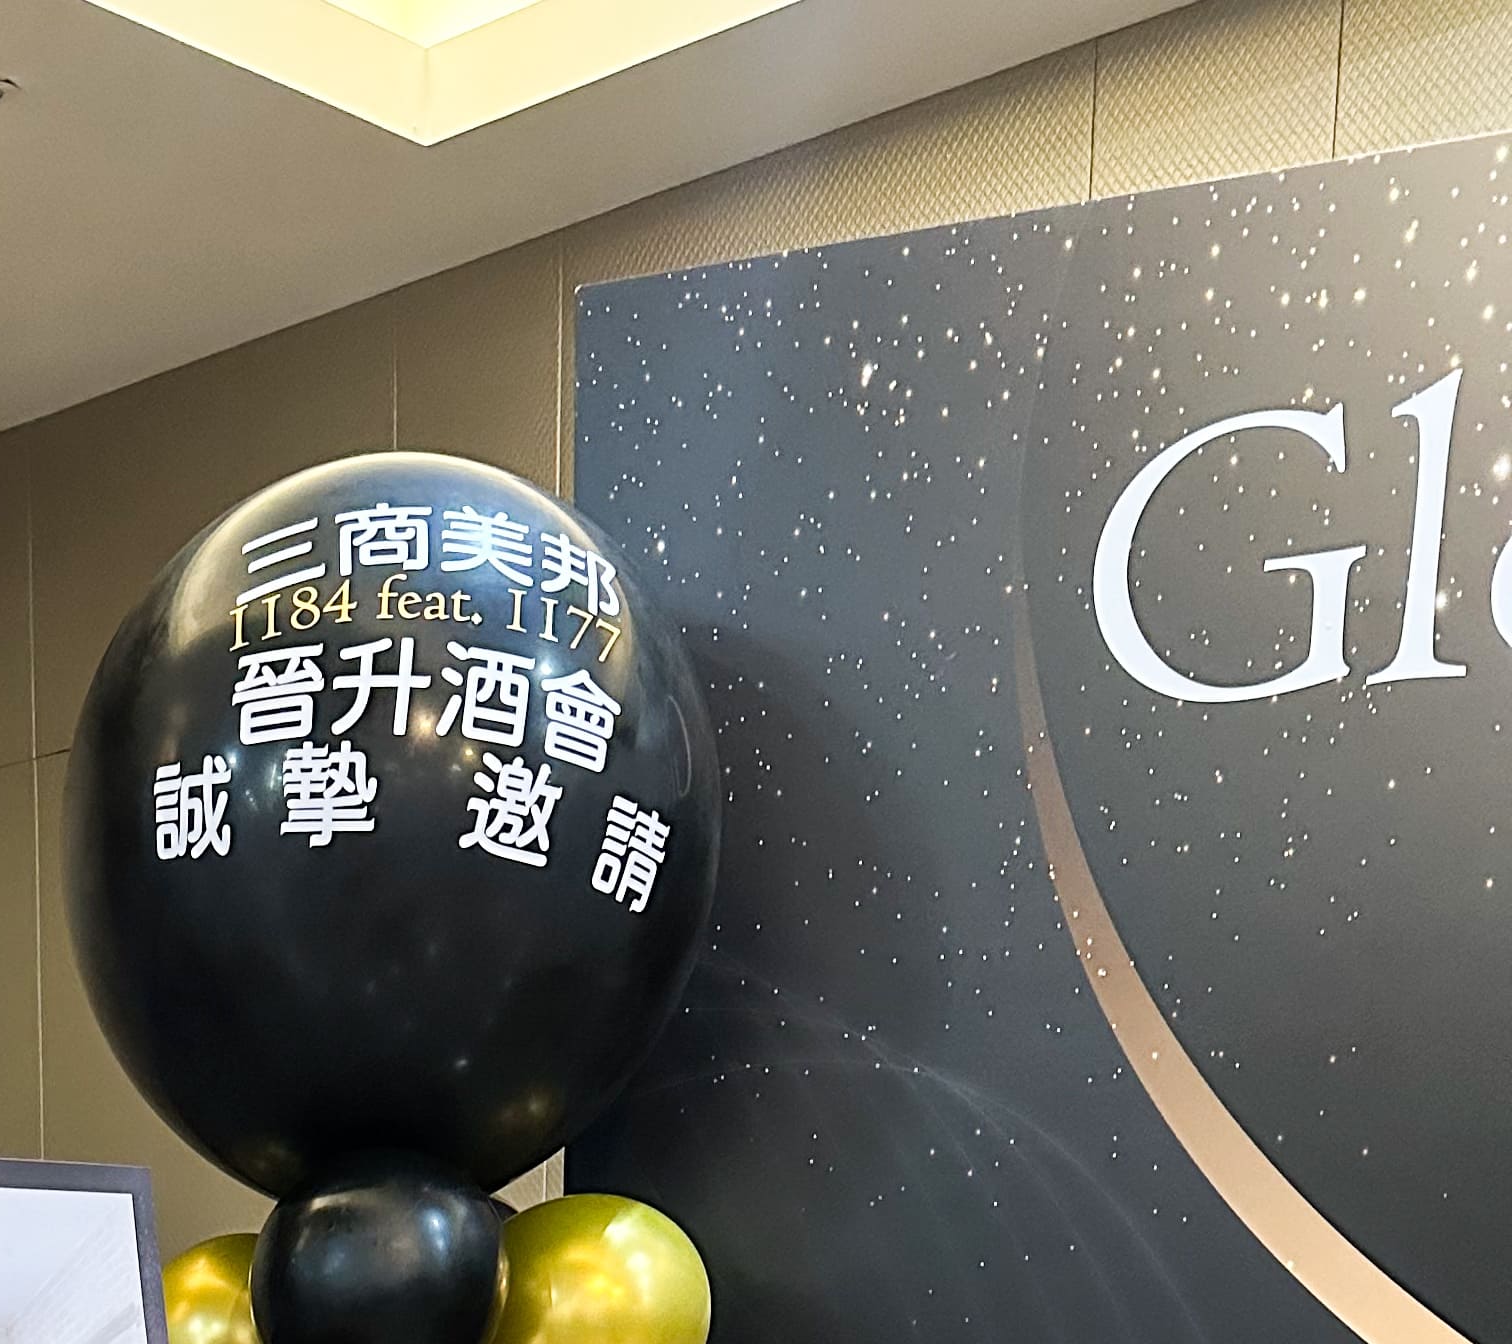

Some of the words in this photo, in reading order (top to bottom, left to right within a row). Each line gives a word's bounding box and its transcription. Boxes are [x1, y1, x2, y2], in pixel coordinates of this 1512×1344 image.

[236, 502, 621, 618] 三商美邦
[1092, 367, 1512, 704] Gl
[229, 578, 357, 652] 1184
[375, 574, 484, 626] feat.
[507, 589, 622, 663] 1177
[231, 636, 622, 774] 晉升酒會
